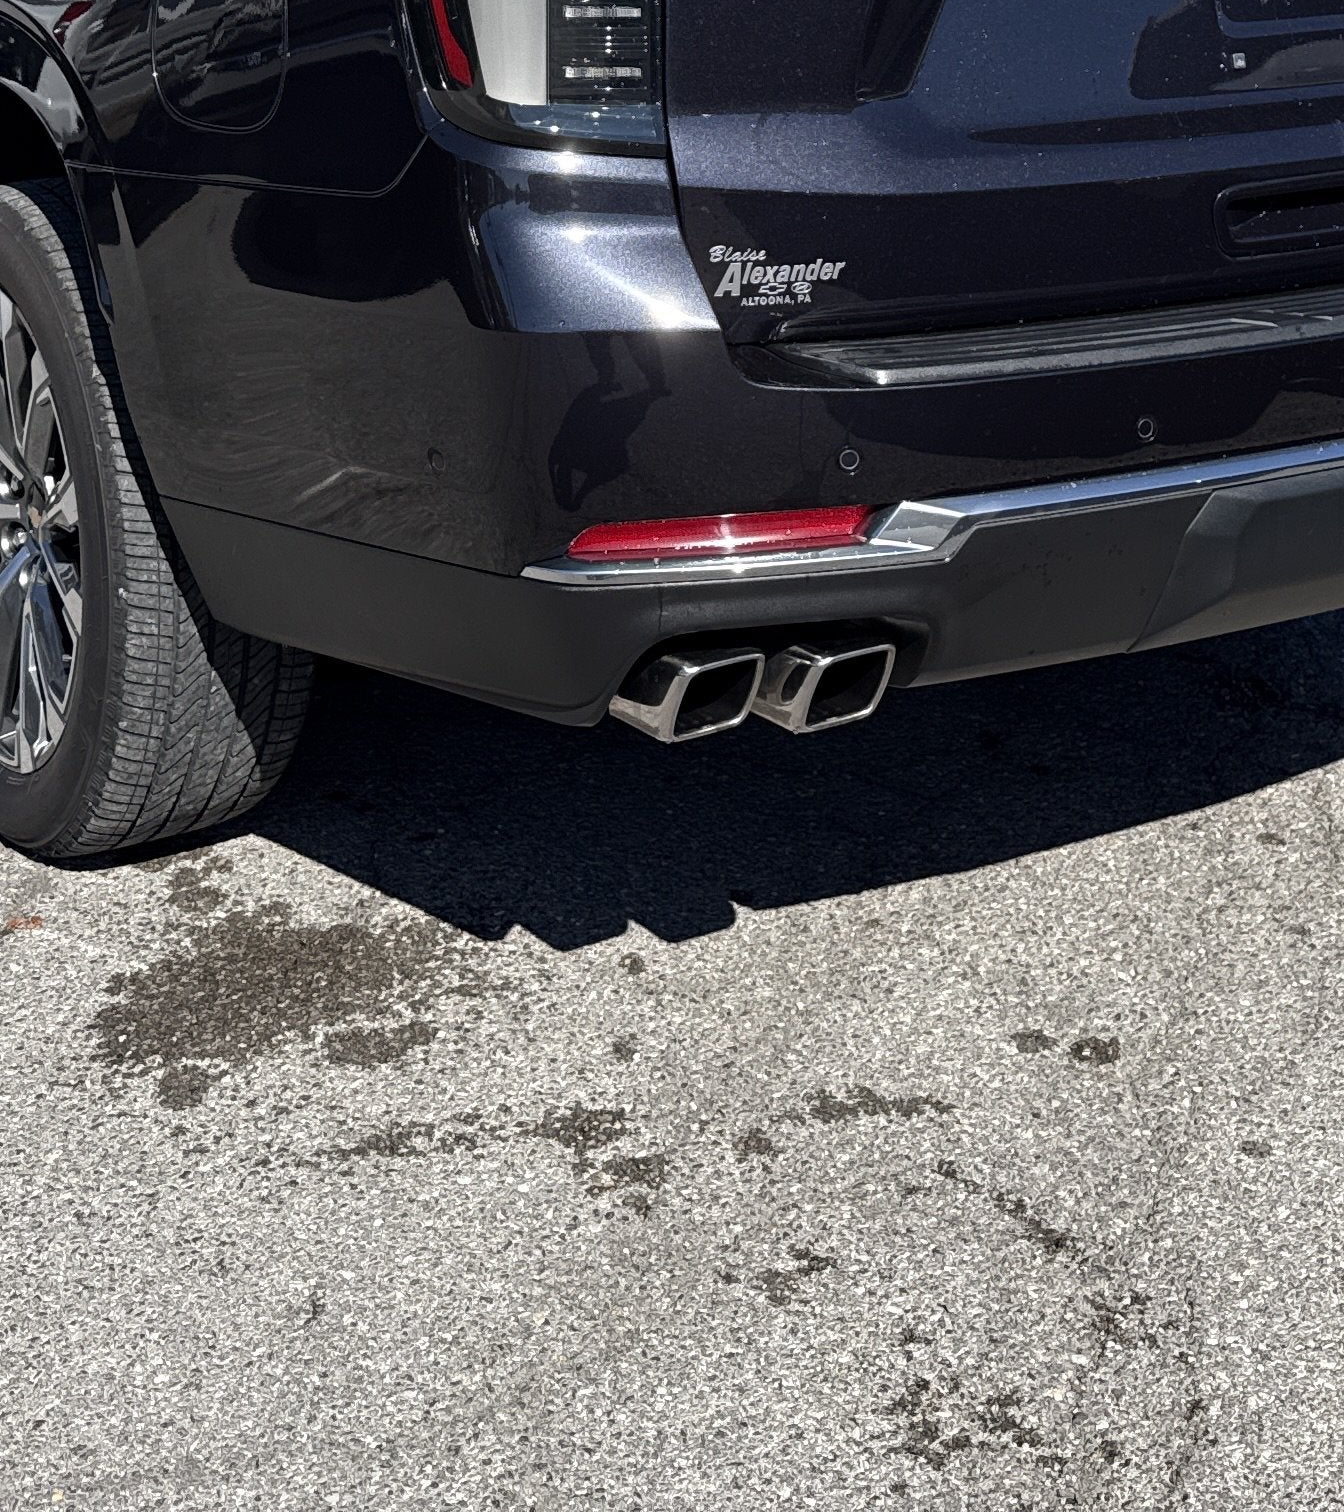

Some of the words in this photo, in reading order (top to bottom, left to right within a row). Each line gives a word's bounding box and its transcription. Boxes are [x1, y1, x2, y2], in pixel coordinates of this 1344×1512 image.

[709, 245, 767, 263] Blaise
[714, 259, 846, 297] Alexander
[740, 295, 795, 307] ALTOONA,
[797, 294, 812, 304] PA
